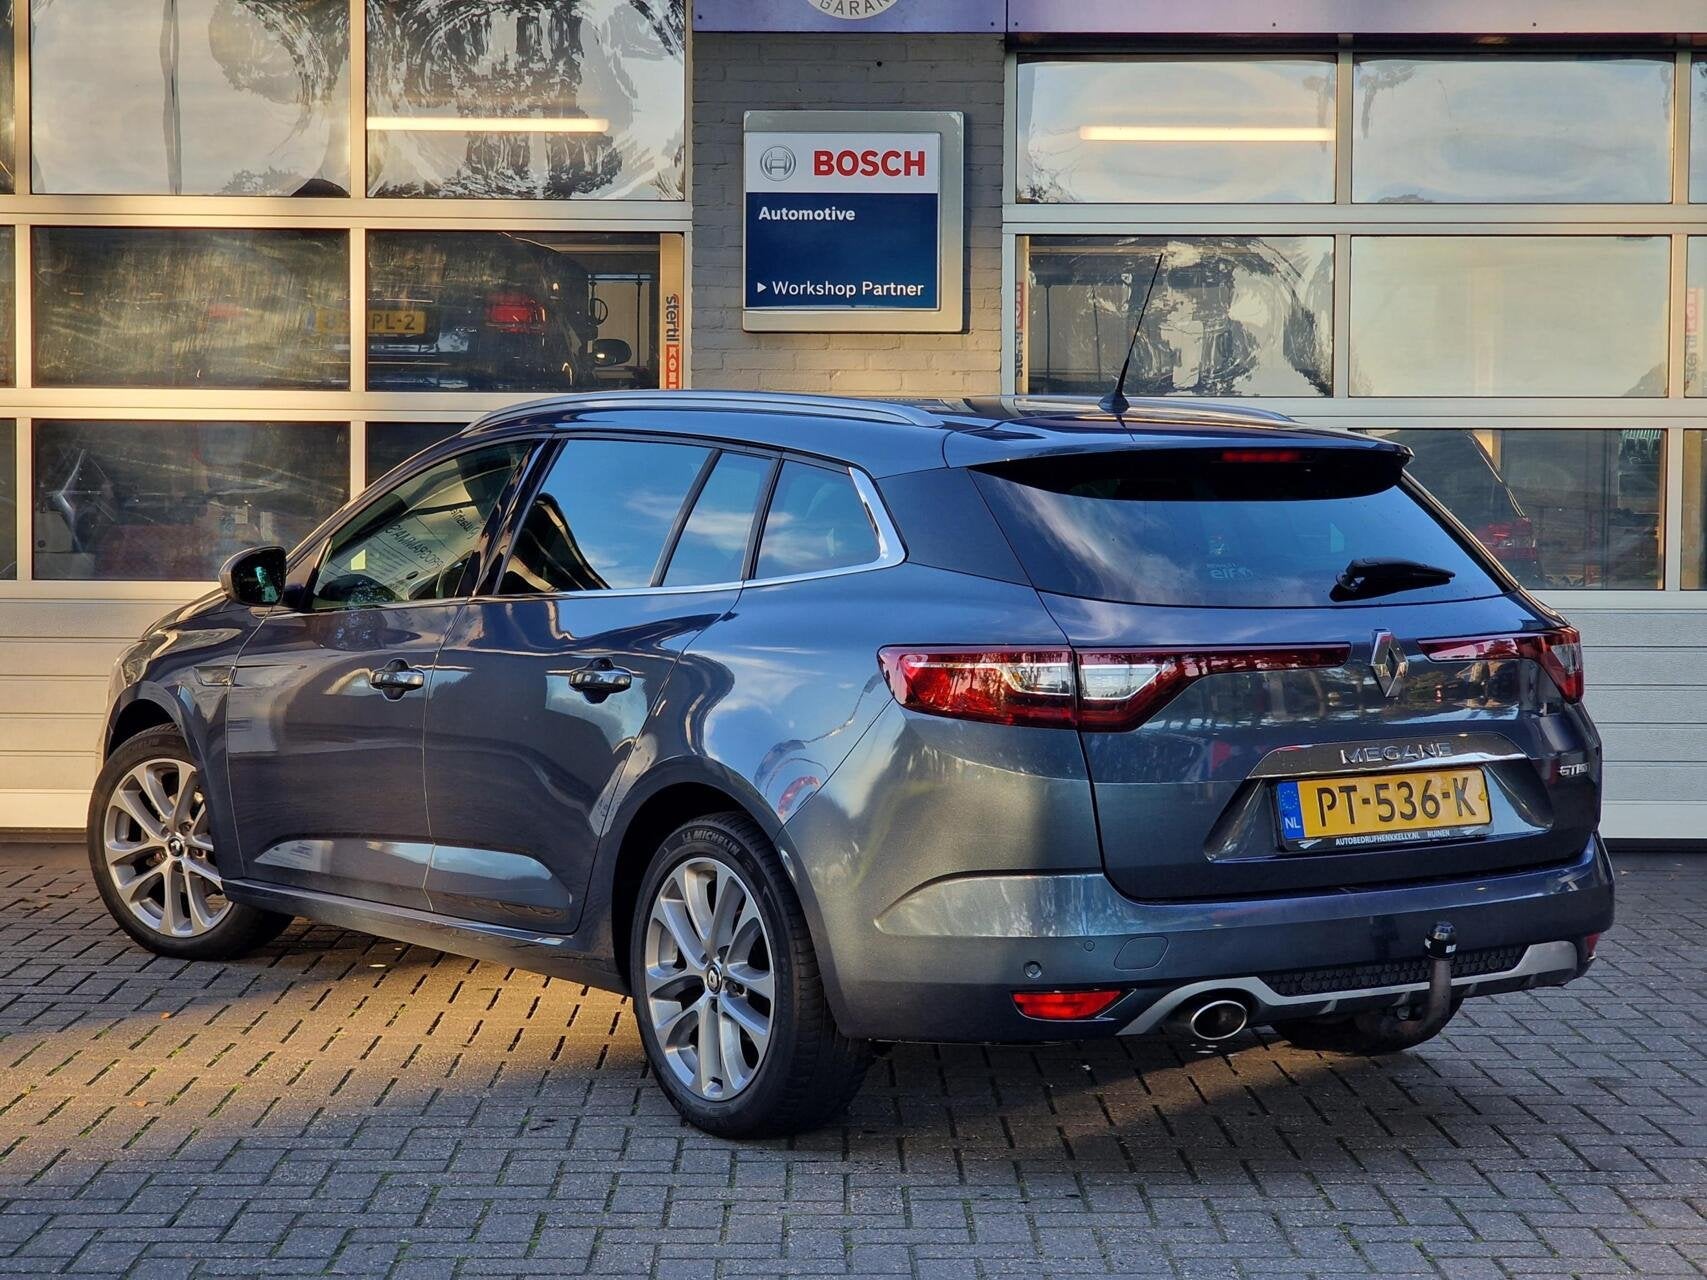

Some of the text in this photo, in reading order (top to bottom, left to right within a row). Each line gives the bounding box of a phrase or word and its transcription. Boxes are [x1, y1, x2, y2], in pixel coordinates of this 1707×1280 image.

[813, 150, 926, 177] BOSCH
[758, 206, 856, 221] Automotive
[772, 281, 925, 298] Workshop Partner
[666, 295, 679, 342] stertil
[1316, 776, 1477, 828] PT-536-K
[1285, 816, 1301, 830] NL
[692, 829, 742, 857] MICHELIN
